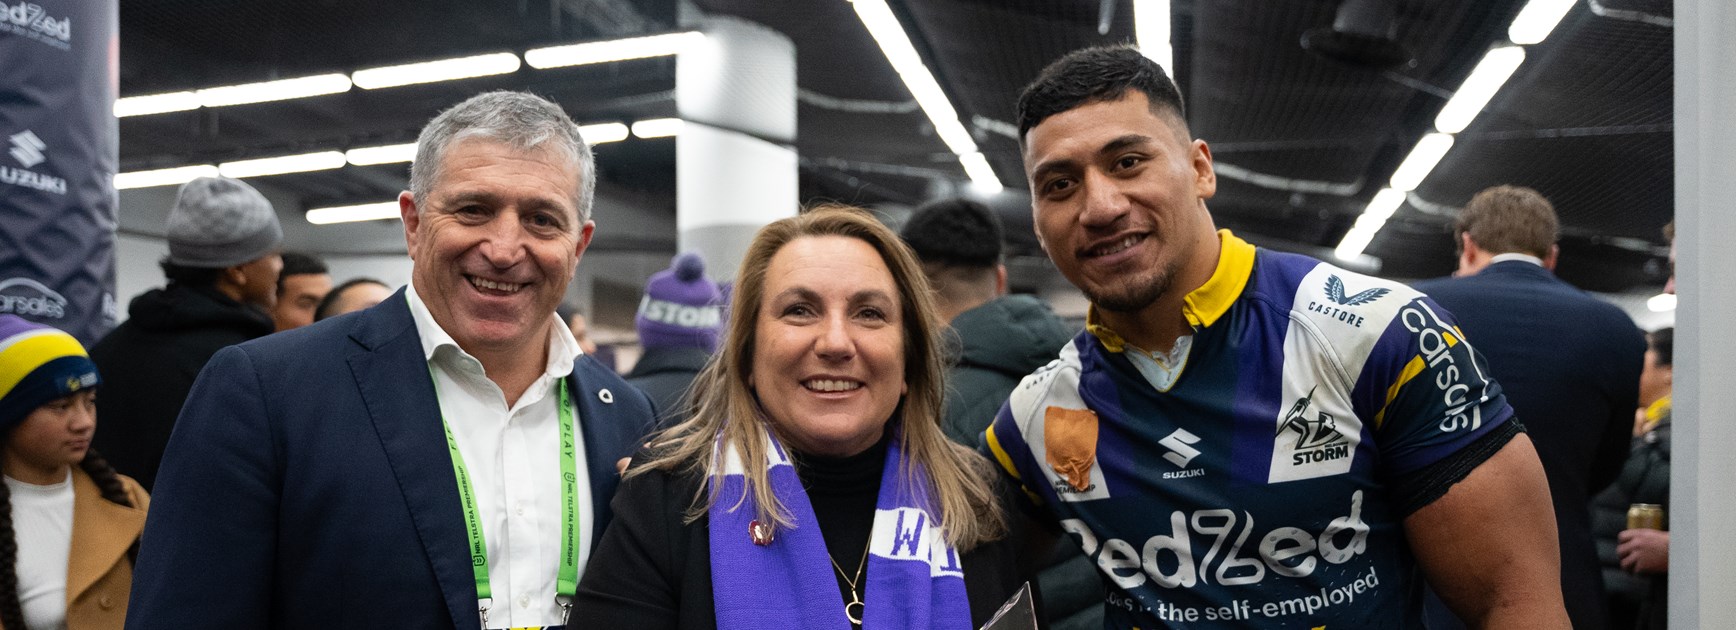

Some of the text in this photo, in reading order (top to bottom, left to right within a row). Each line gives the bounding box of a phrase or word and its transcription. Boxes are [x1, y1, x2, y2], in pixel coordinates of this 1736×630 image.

[1308, 301, 1365, 328] CASTORE
[563, 399, 571, 416] OF
[563, 422, 573, 459] PLAY
[1293, 445, 1349, 466] STORM
[458, 465, 472, 509] PREMIERSHIP
[1162, 468, 1205, 480] SUZUKI
[469, 509, 479, 540] TELSTRA
[1158, 602, 1199, 622] the
[1205, 566, 1379, 621] self-employed
